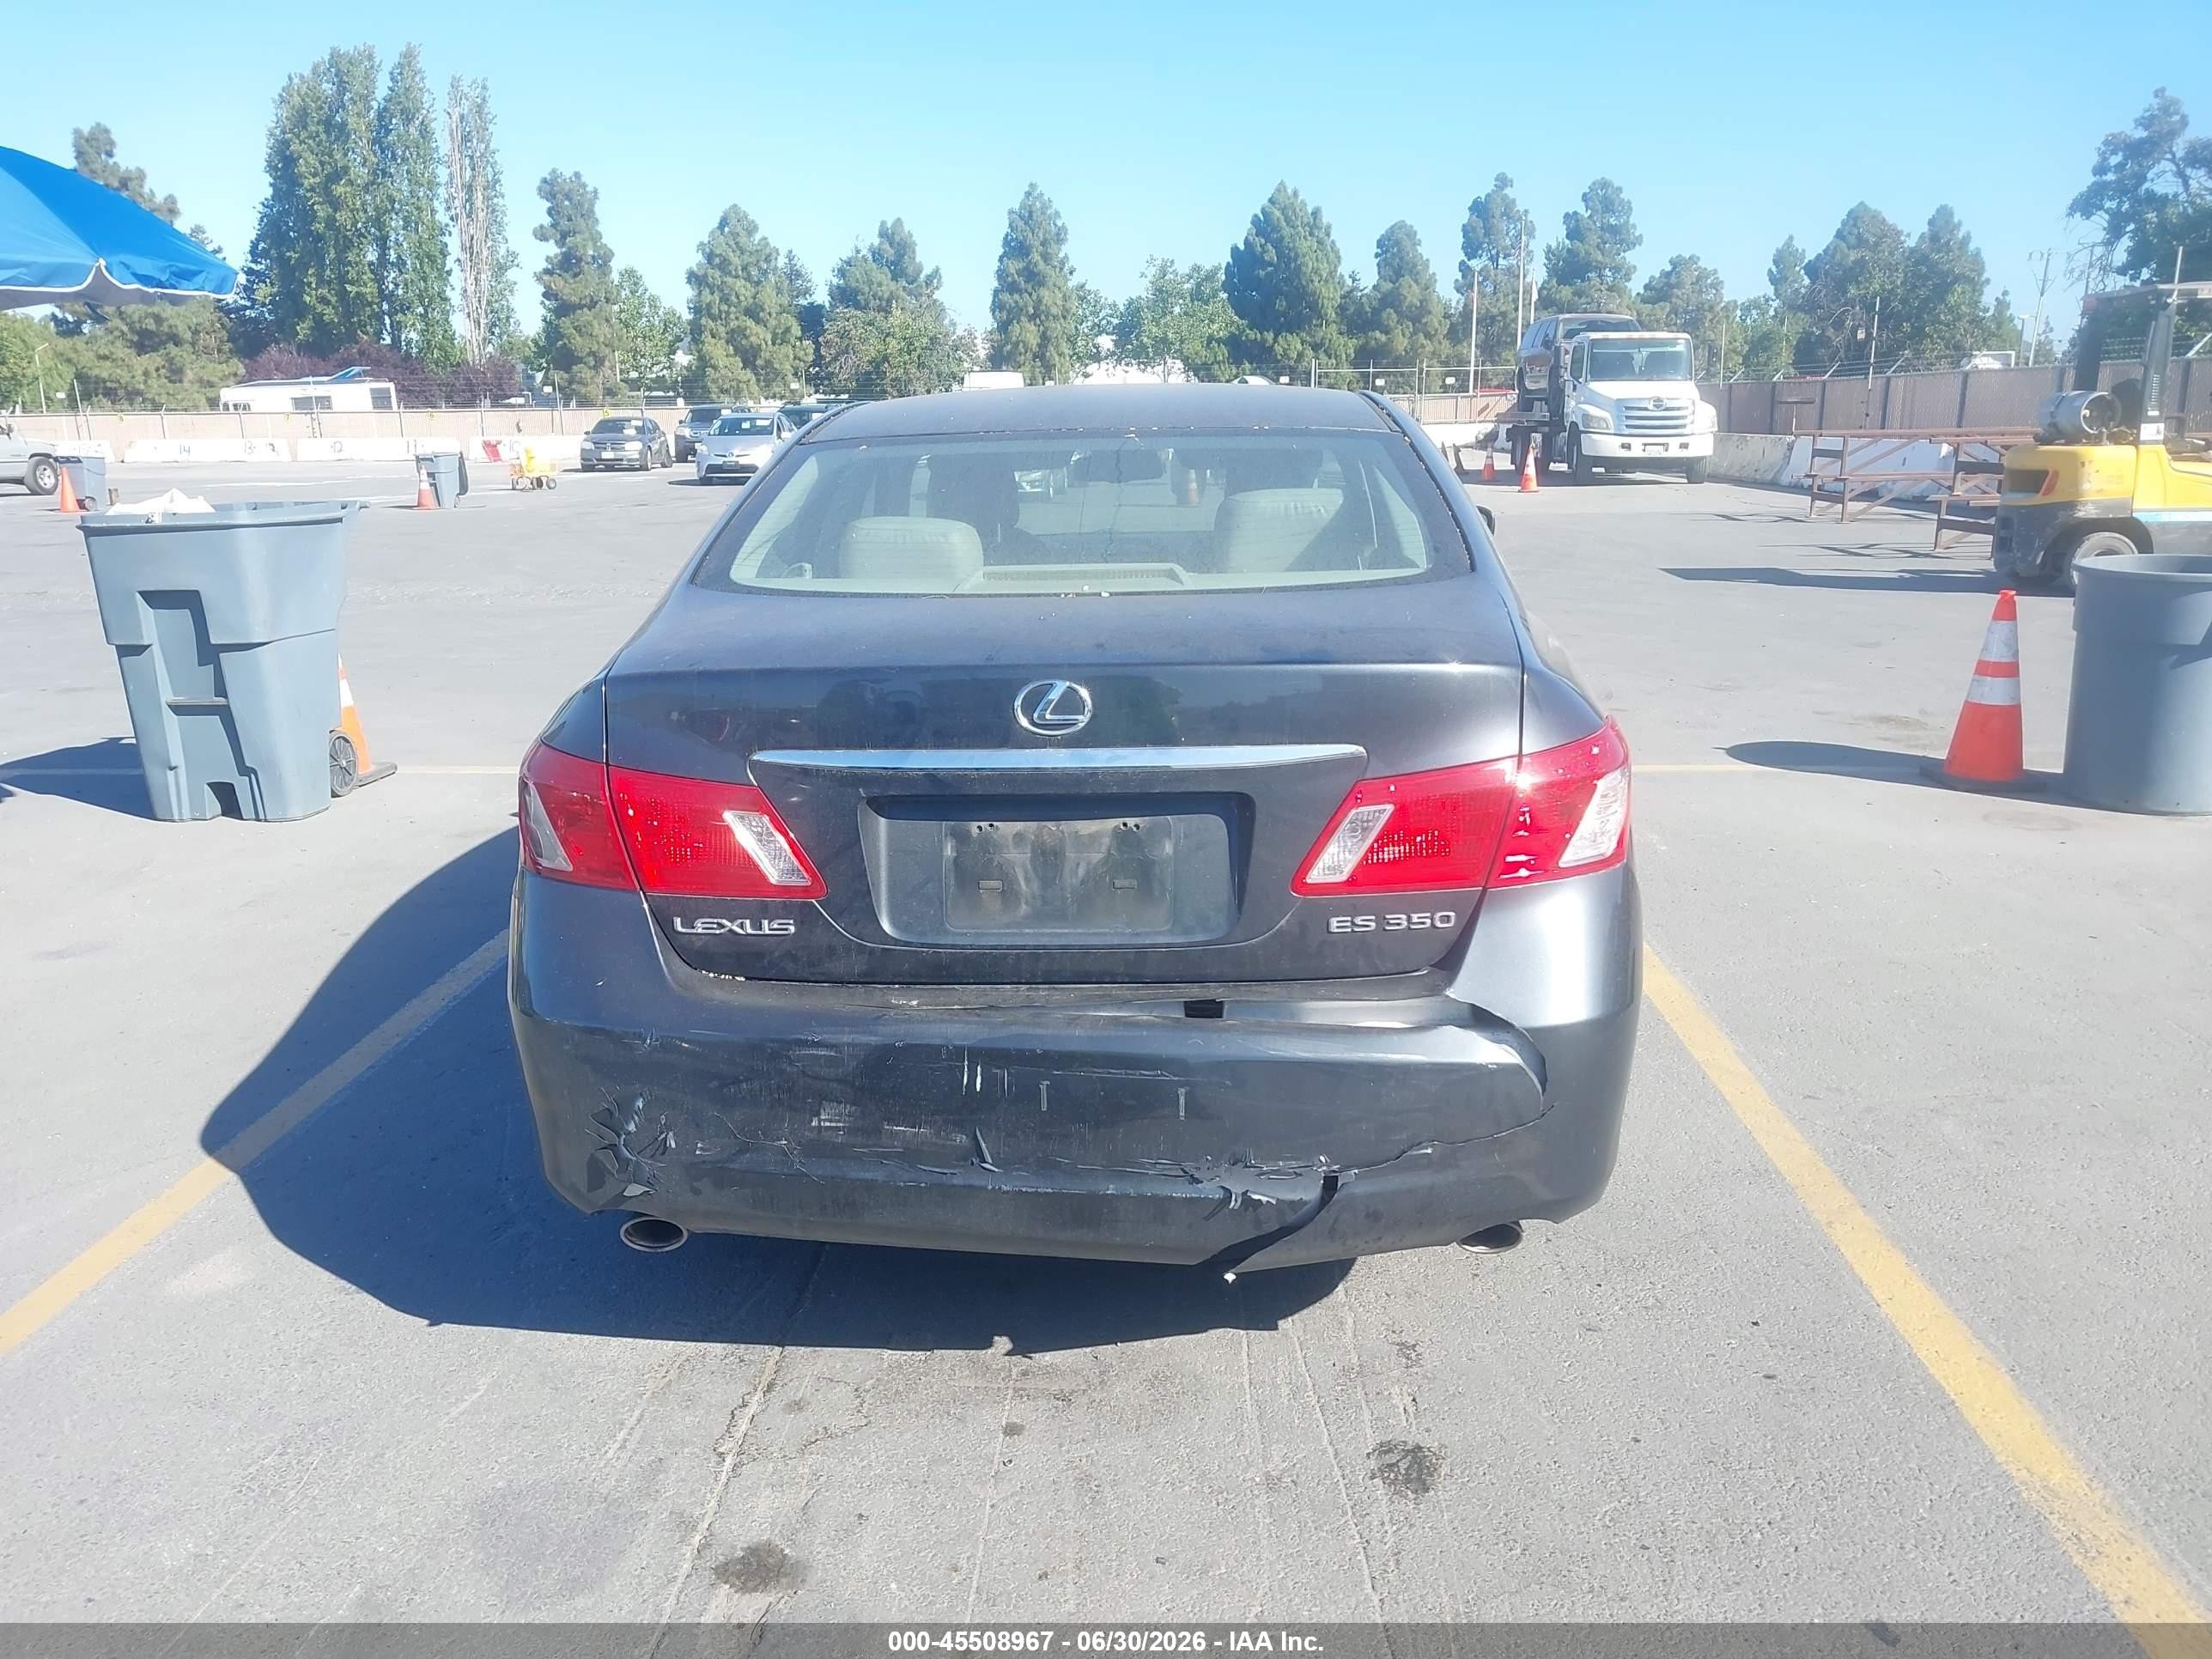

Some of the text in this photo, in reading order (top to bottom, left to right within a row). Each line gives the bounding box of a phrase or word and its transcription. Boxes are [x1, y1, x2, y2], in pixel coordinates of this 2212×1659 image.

[179, 444, 191, 455] 14
[672, 916, 795, 935] LEXUS
[1328, 911, 1456, 933] ES 350
